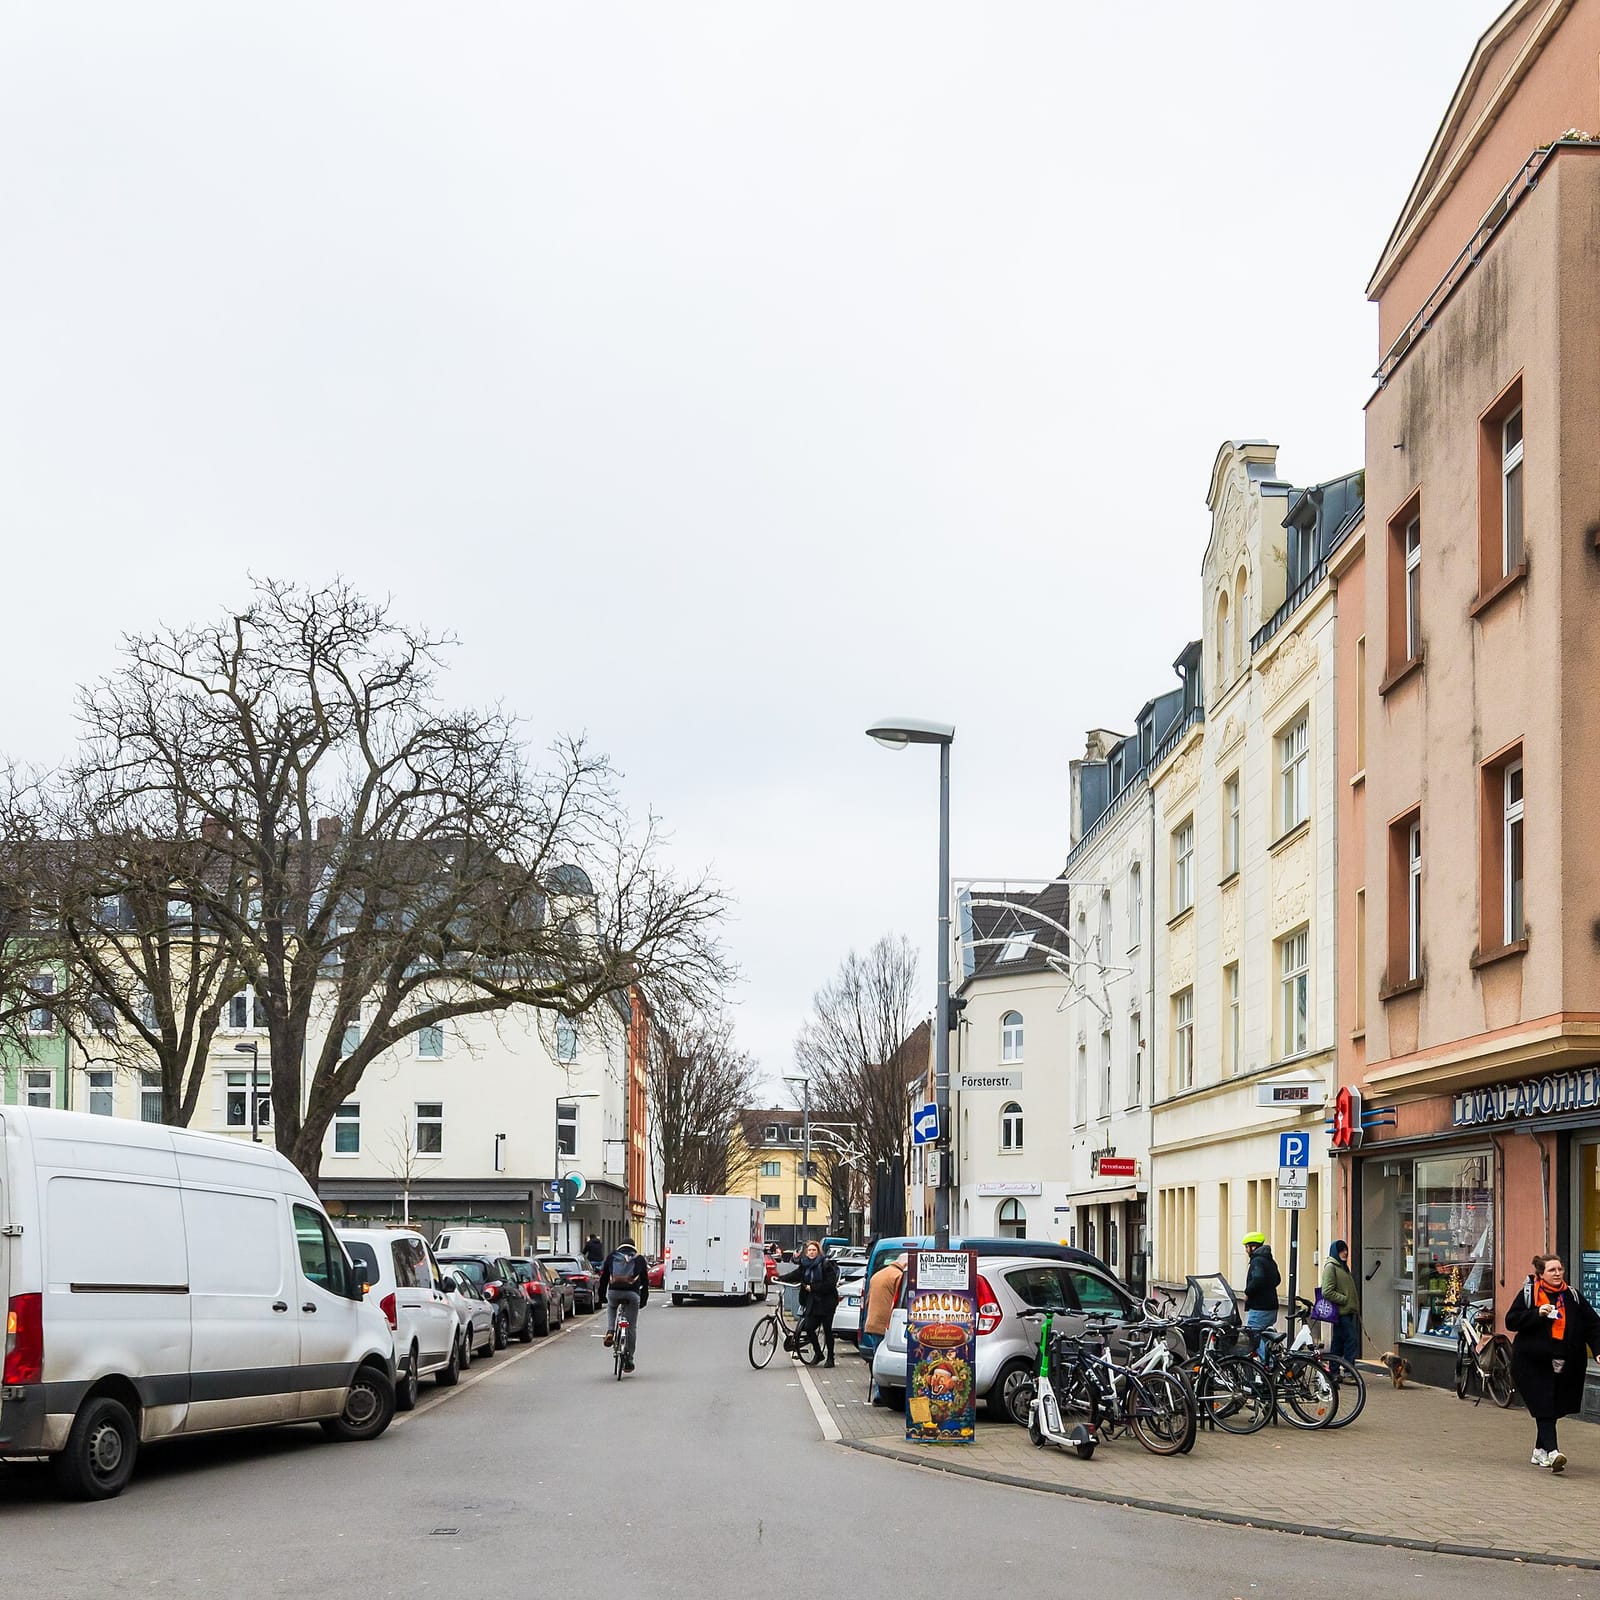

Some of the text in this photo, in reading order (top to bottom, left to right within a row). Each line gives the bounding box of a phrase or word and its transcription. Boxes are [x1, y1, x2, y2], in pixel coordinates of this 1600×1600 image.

[961, 1075, 1012, 1087] Försterstr.
[1286, 1137, 1303, 1166] P
[1283, 1191, 1303, 1200] werktags
[919, 1253, 968, 1265] Köln Ehrenfeld
[911, 1292, 972, 1314] CIRCUS
[909, 1312, 940, 1322] CHARLES
